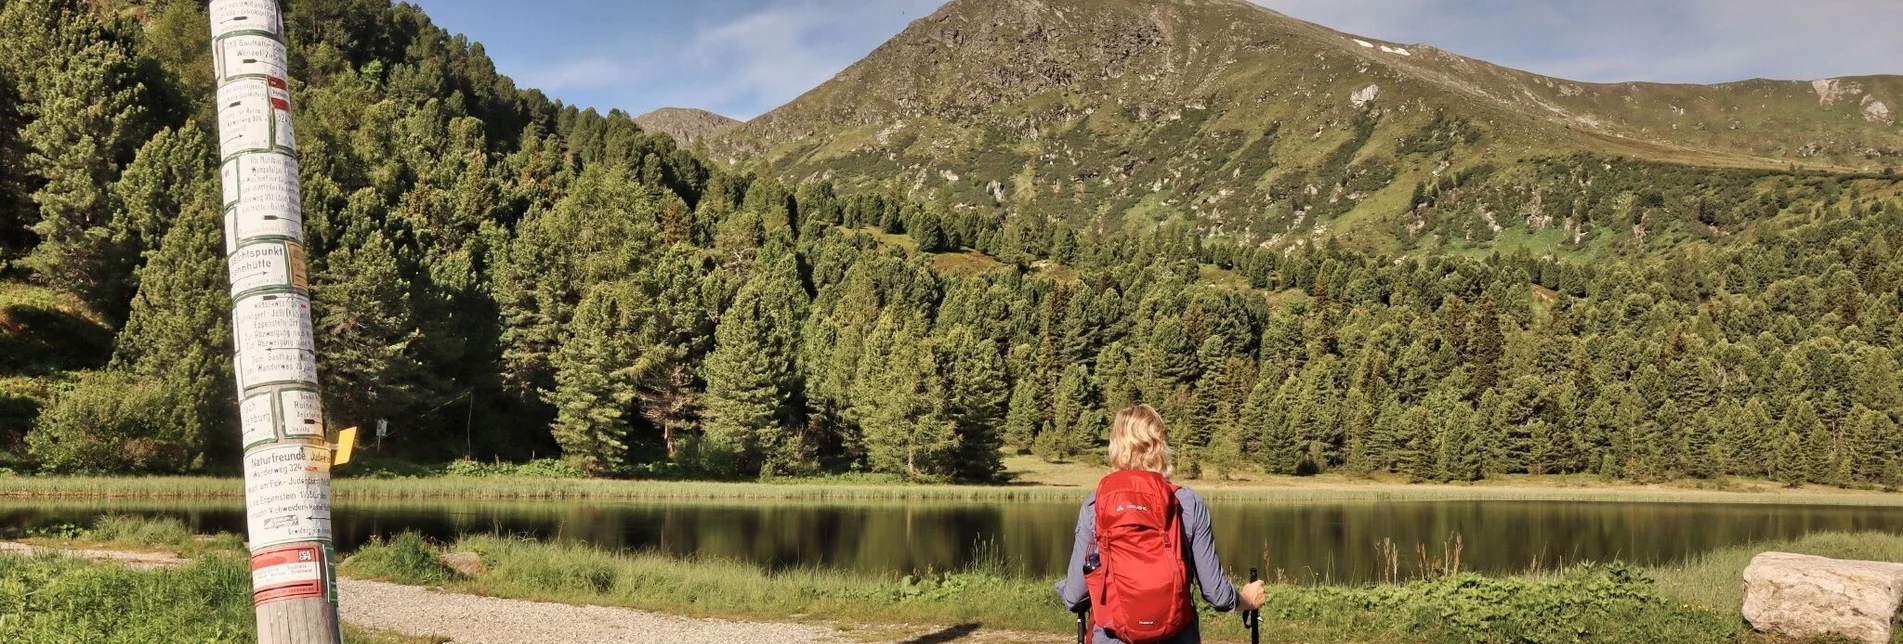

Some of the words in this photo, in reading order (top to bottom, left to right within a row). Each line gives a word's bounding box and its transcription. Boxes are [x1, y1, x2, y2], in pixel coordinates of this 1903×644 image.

[252, 451, 306, 467] Naturfreunde
[253, 466, 287, 479] Wanderweg
[290, 463, 302, 472] 324
[270, 478, 282, 488] Eck
[260, 492, 296, 505] Eppenstein
